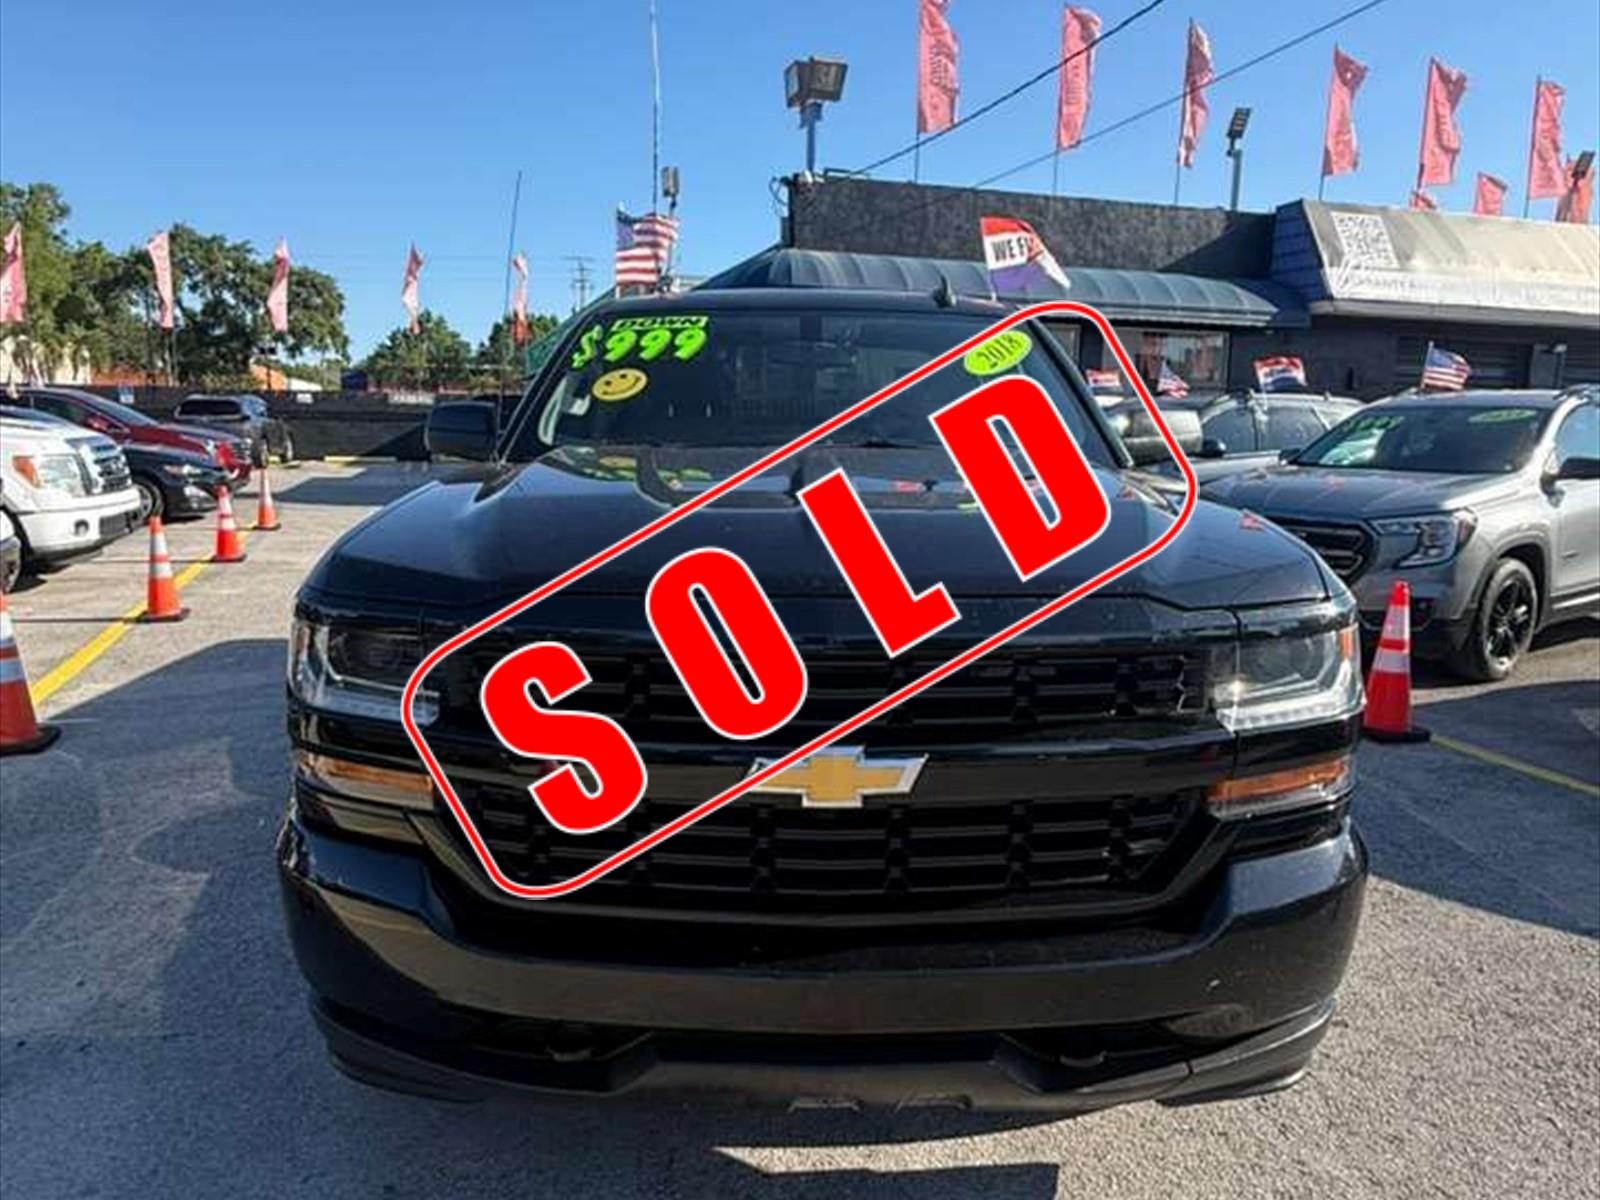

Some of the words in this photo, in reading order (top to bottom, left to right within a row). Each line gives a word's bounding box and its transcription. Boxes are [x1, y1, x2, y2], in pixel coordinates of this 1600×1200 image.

[990, 238, 1016, 262] WE
[612, 316, 708, 331] DOWN
[571, 324, 707, 369] $999
